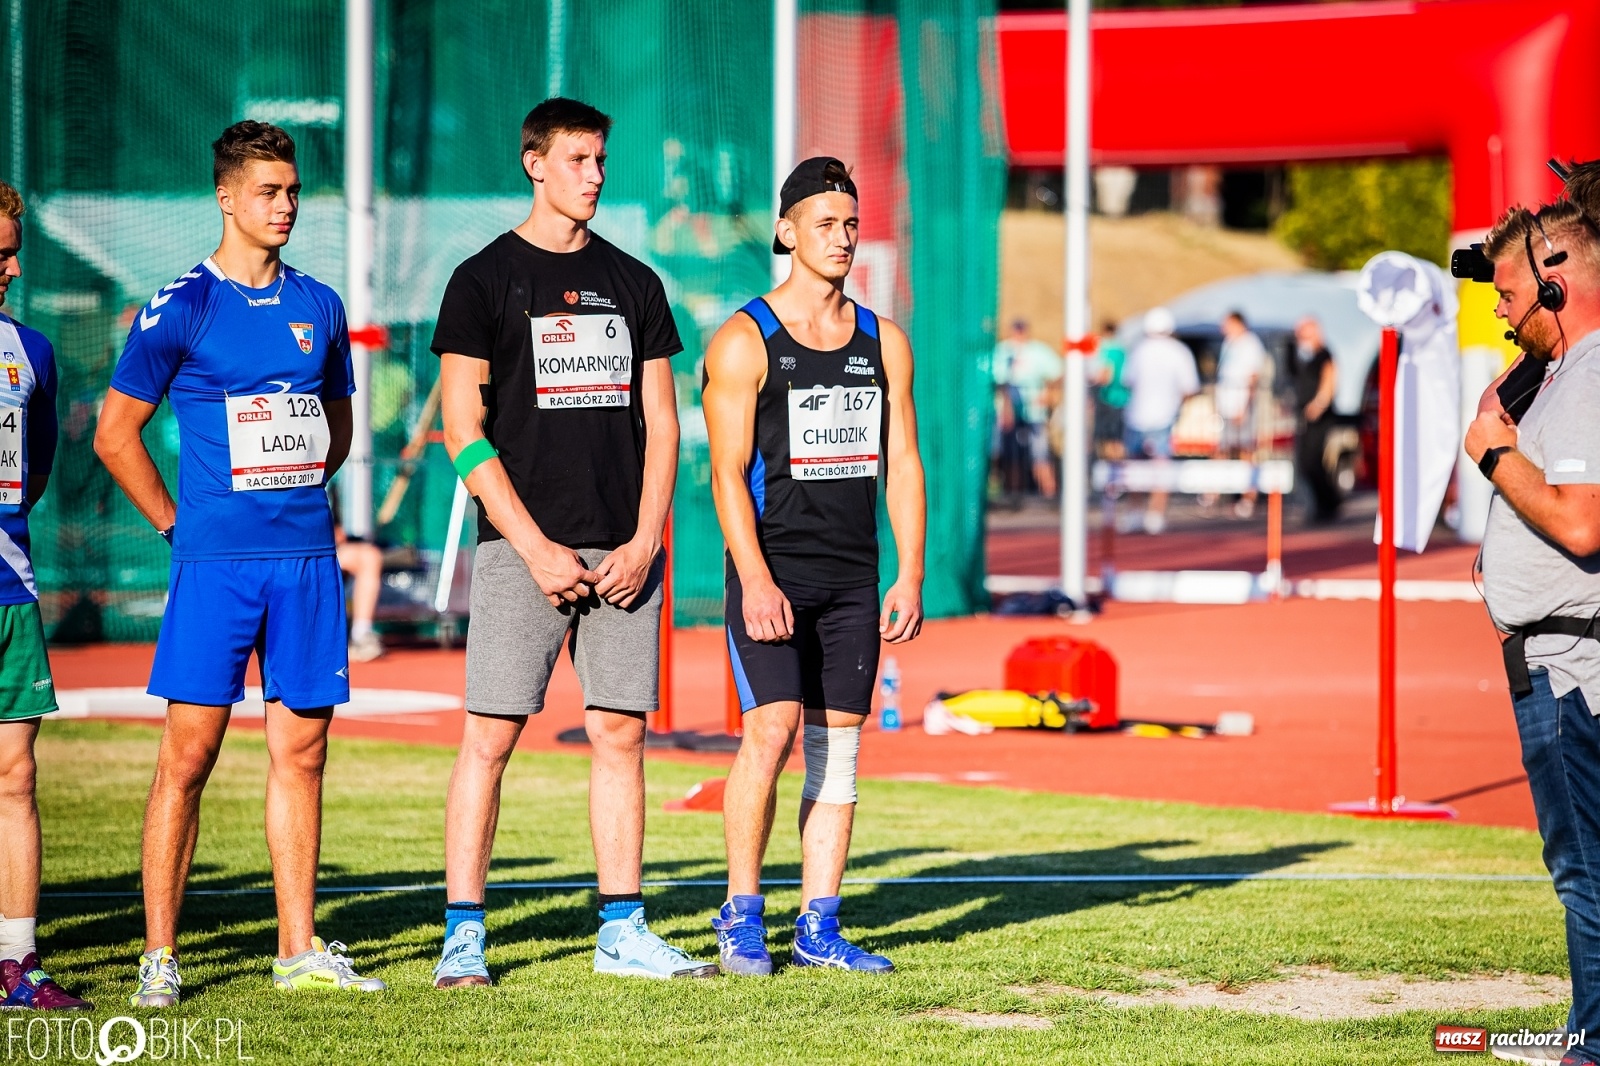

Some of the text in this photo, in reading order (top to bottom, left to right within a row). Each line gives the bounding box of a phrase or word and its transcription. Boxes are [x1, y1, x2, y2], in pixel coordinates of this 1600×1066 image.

[543, 334, 574, 343] ORLEN
[605, 319, 617, 339] 6
[538, 355, 630, 375] KOMARNICKI
[848, 356, 869, 366] ULKS
[286, 397, 321, 418] 128
[549, 392, 603, 406] RACIBÓRZ
[798, 394, 830, 411] 4F
[843, 391, 877, 412] 167
[0, 412, 17, 433] 4
[239, 411, 271, 422] ORLEN
[261, 434, 307, 453] LADA
[803, 426, 868, 445] CHUDZIK
[246, 472, 315, 487] RACIBÓRZ 2019
[803, 464, 867, 477] RACIBÓRZ 2019
[441, 943, 471, 965] NIKE
